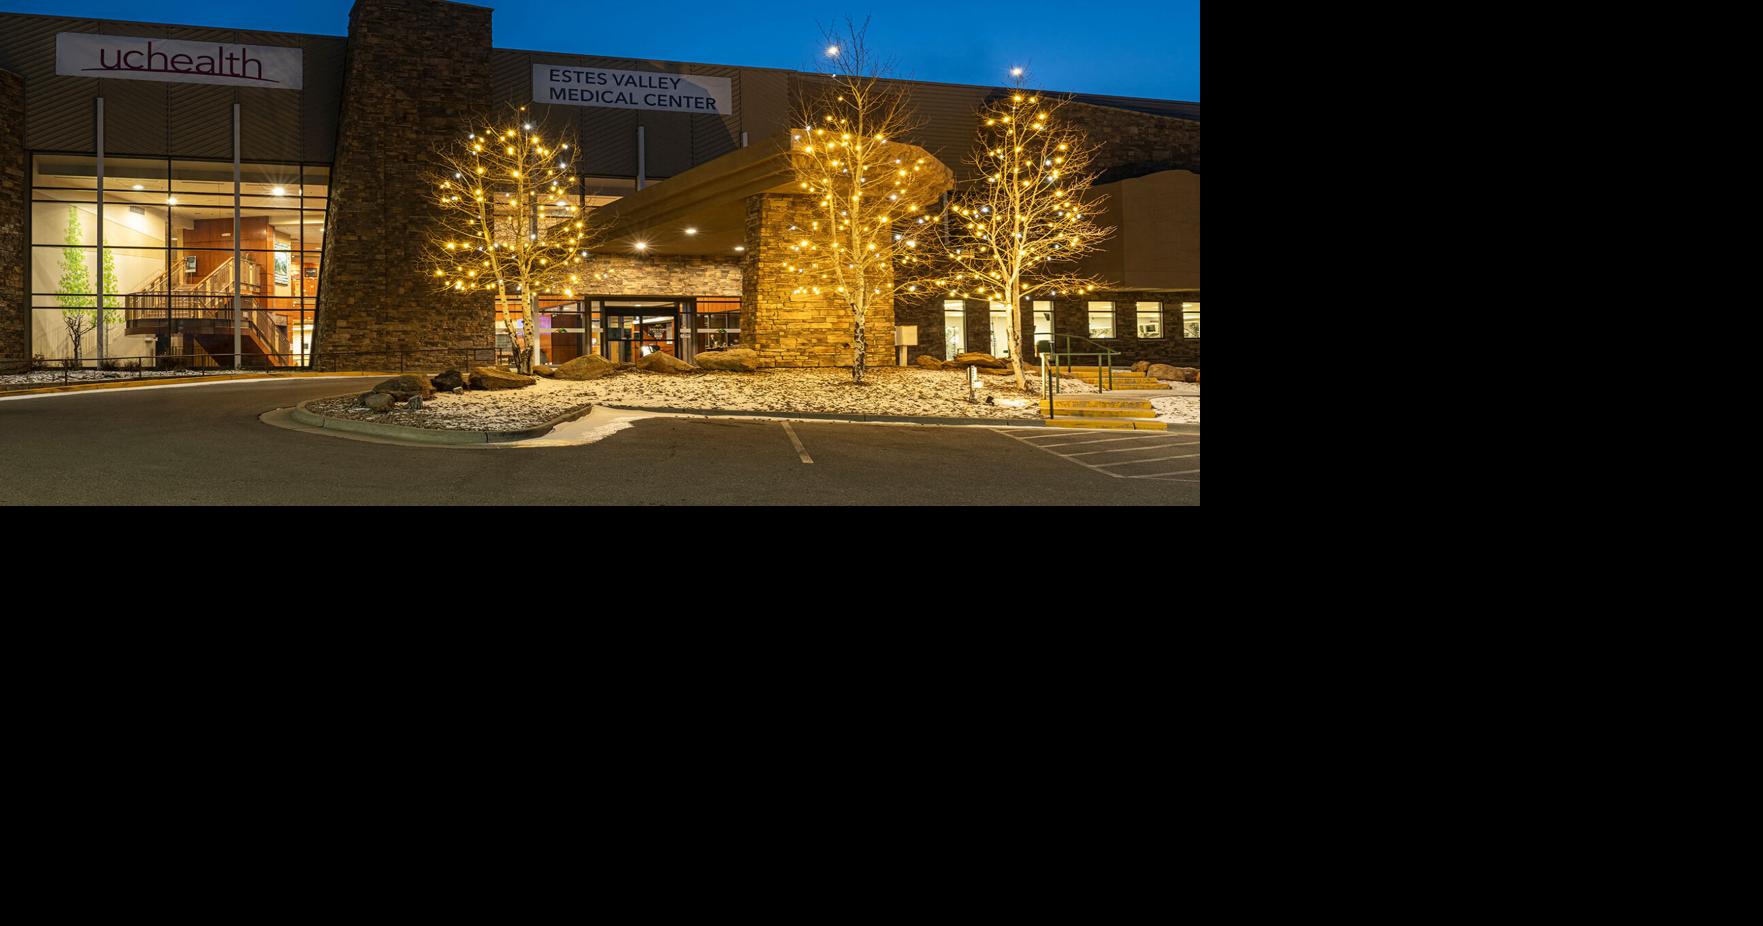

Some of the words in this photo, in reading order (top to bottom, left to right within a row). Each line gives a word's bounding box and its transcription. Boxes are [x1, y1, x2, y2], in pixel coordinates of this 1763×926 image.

[100, 41, 262, 80] uchealth
[549, 69, 608, 85] ESTES
[612, 73, 681, 90] VALLEY
[549, 87, 639, 105] MEDICAL
[644, 93, 716, 110] CENTER
